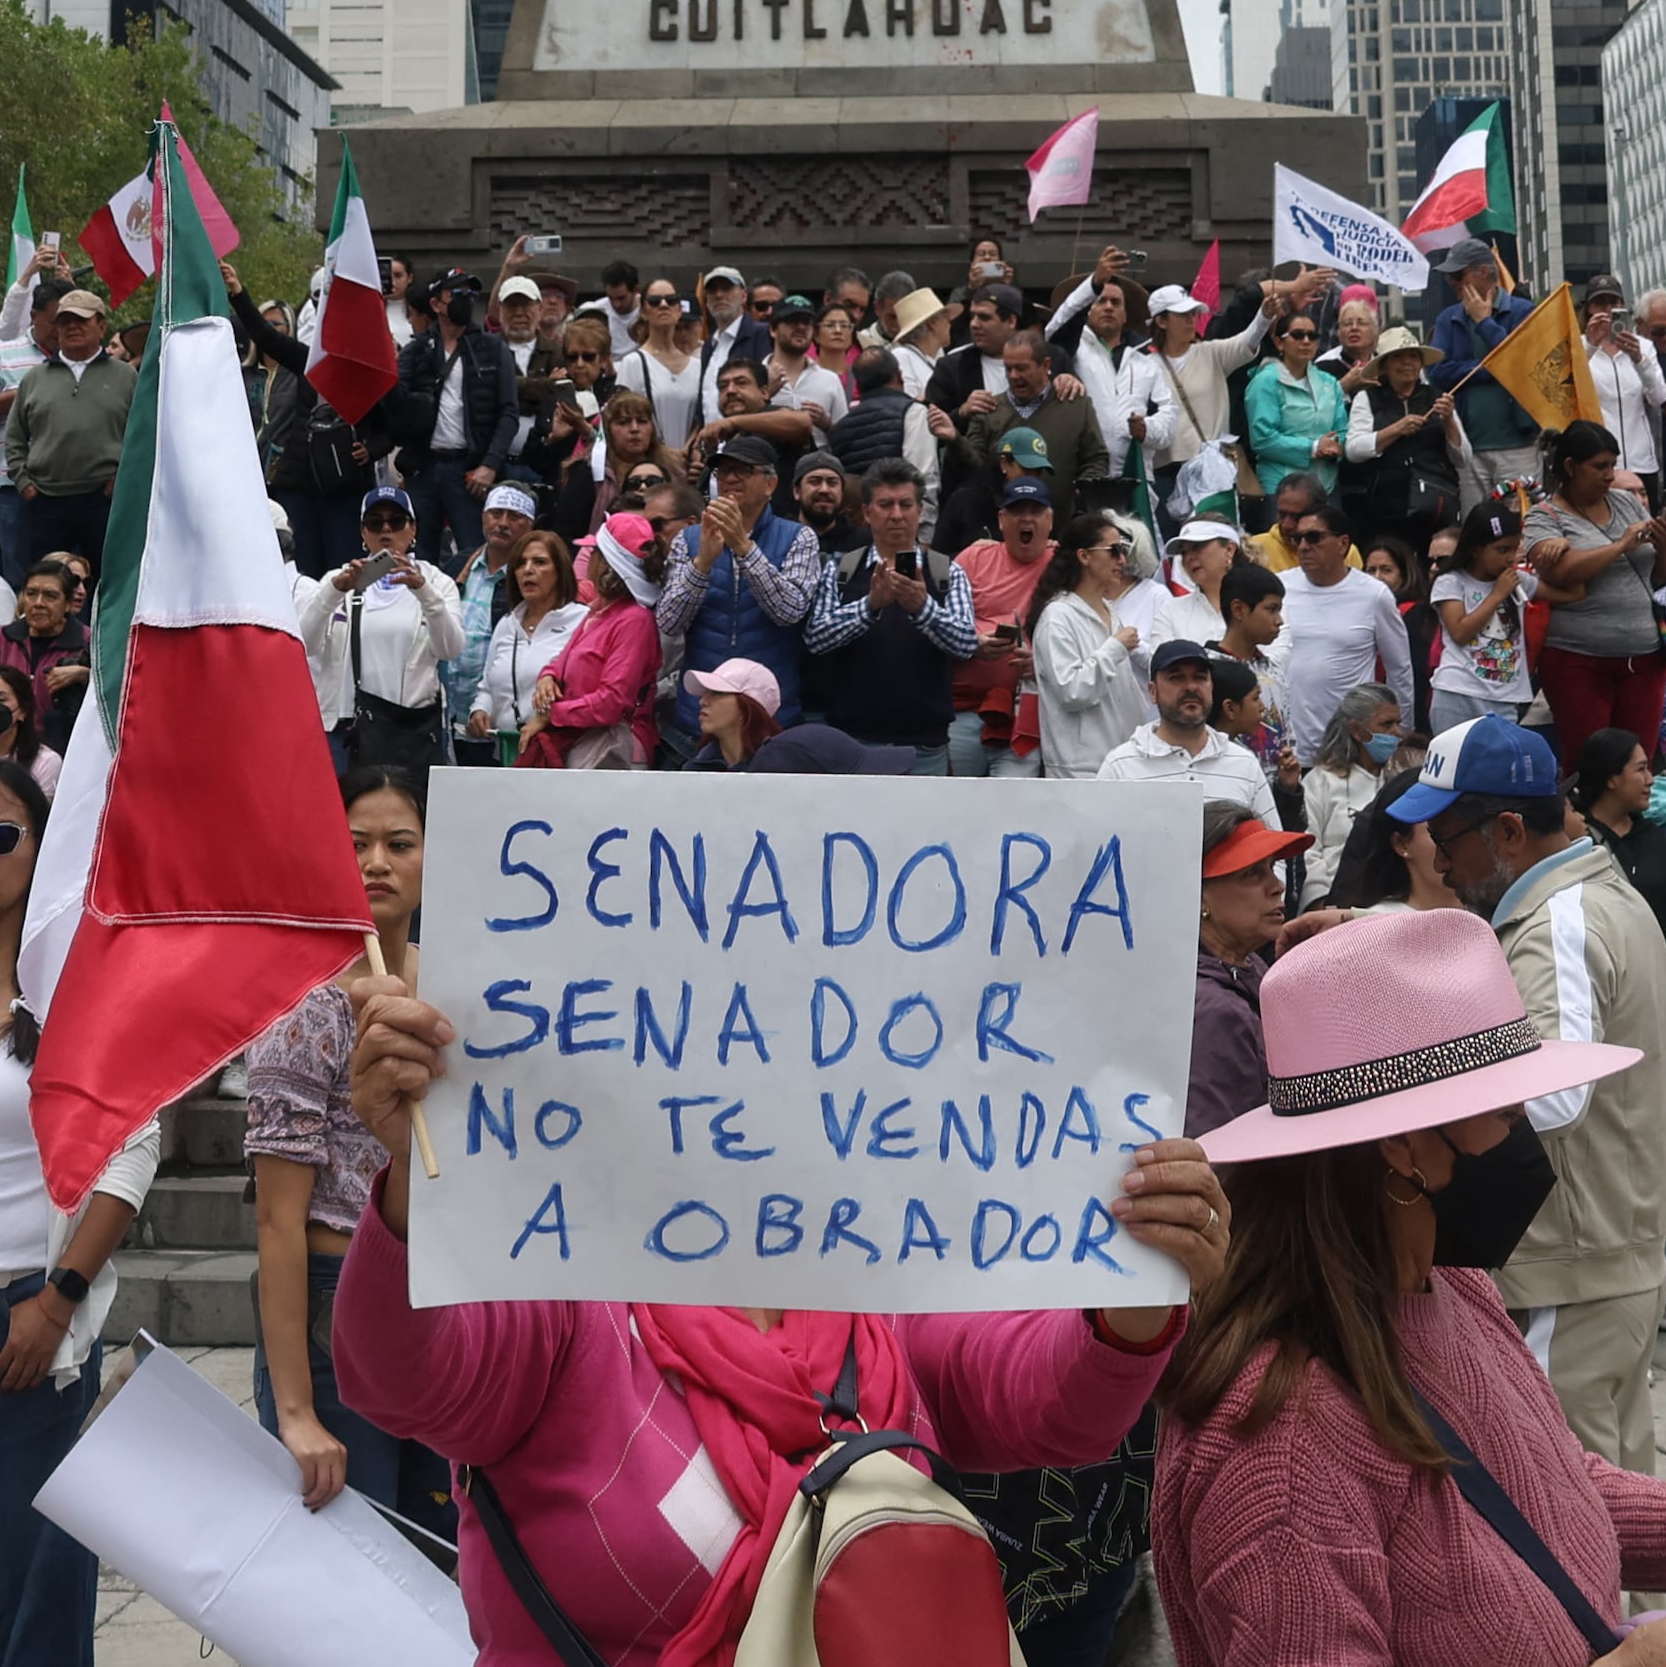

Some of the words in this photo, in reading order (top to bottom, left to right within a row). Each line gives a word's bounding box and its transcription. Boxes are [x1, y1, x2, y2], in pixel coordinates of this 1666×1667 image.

[484, 819, 1135, 955] SENADORA
[463, 977, 1054, 1070] SENADOR
[466, 1082, 583, 1160] NO
[658, 1095, 776, 1162] TE
[819, 1087, 1163, 1171] VENDAS
[510, 1182, 570, 1260] A
[645, 1195, 1136, 1276] OBRADOR
